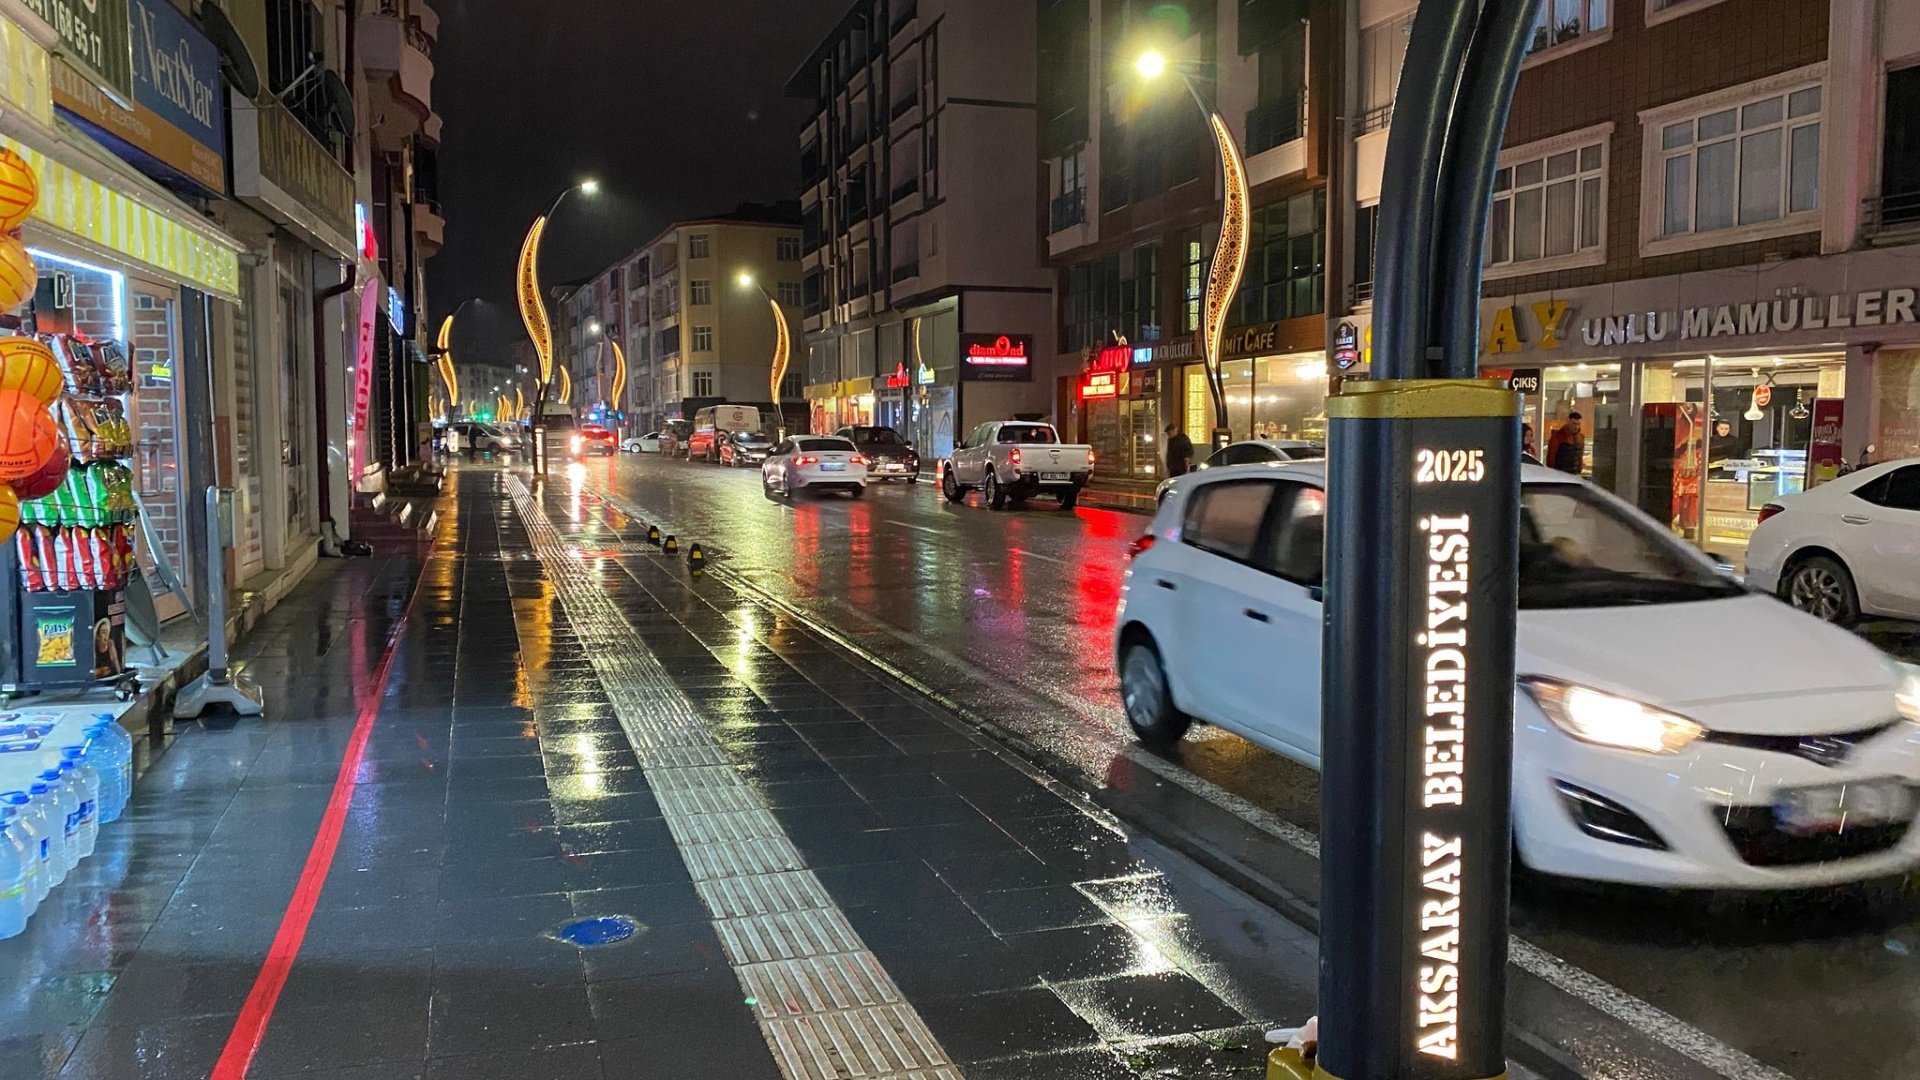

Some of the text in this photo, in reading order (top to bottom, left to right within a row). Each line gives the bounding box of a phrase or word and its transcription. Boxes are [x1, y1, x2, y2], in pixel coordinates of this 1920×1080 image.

[75, 16, 88, 56] 55
[90, 31, 101, 67] 17
[1582, 311, 1668, 346] UNLU
[1512, 377, 1538, 391] ÇIKIŞ
[1416, 449, 1485, 483] 2025
[1416, 514, 1469, 1060] AKSARAY BELEDİYESİ
